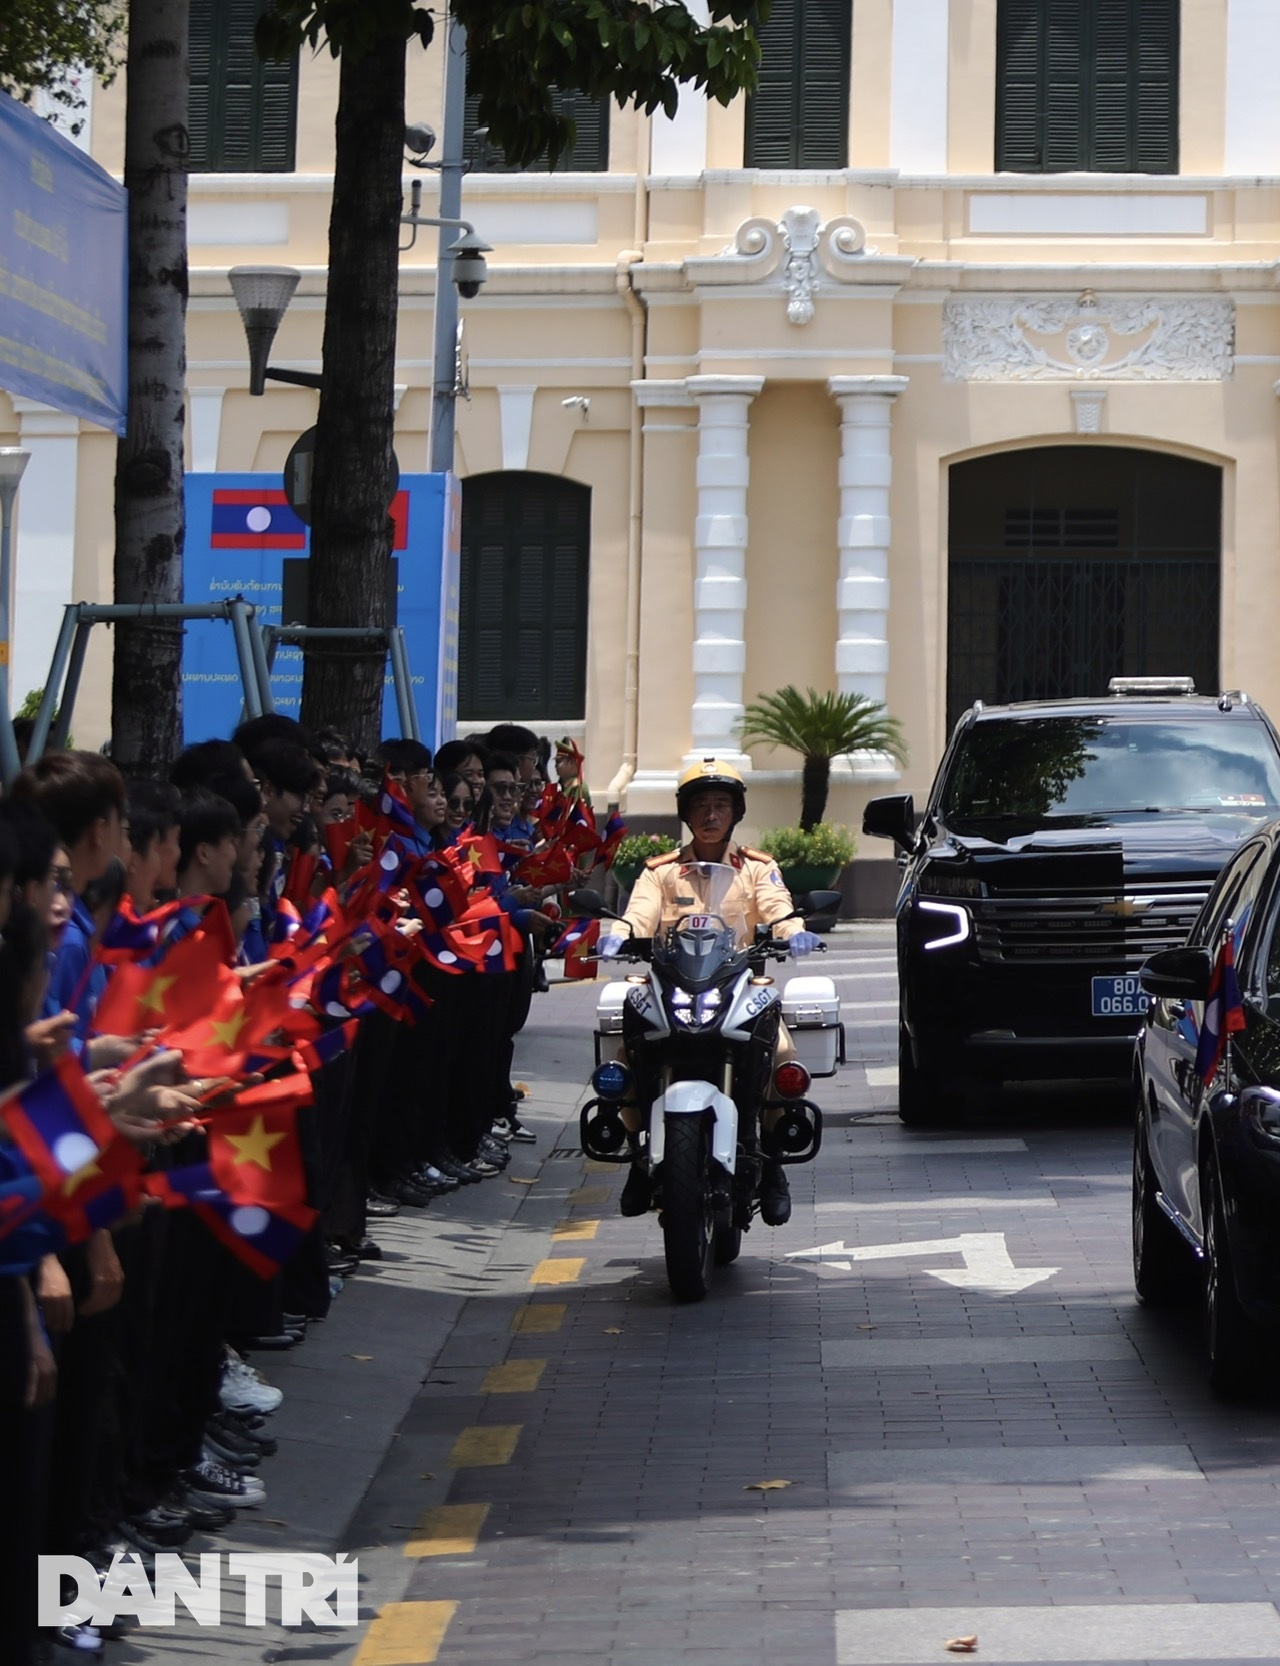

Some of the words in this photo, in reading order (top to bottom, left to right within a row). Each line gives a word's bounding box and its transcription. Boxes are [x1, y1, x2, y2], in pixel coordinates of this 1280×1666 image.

[692, 916, 708, 928] 07
[629, 987, 654, 1016] CSGT
[745, 987, 773, 1017] CSGT
